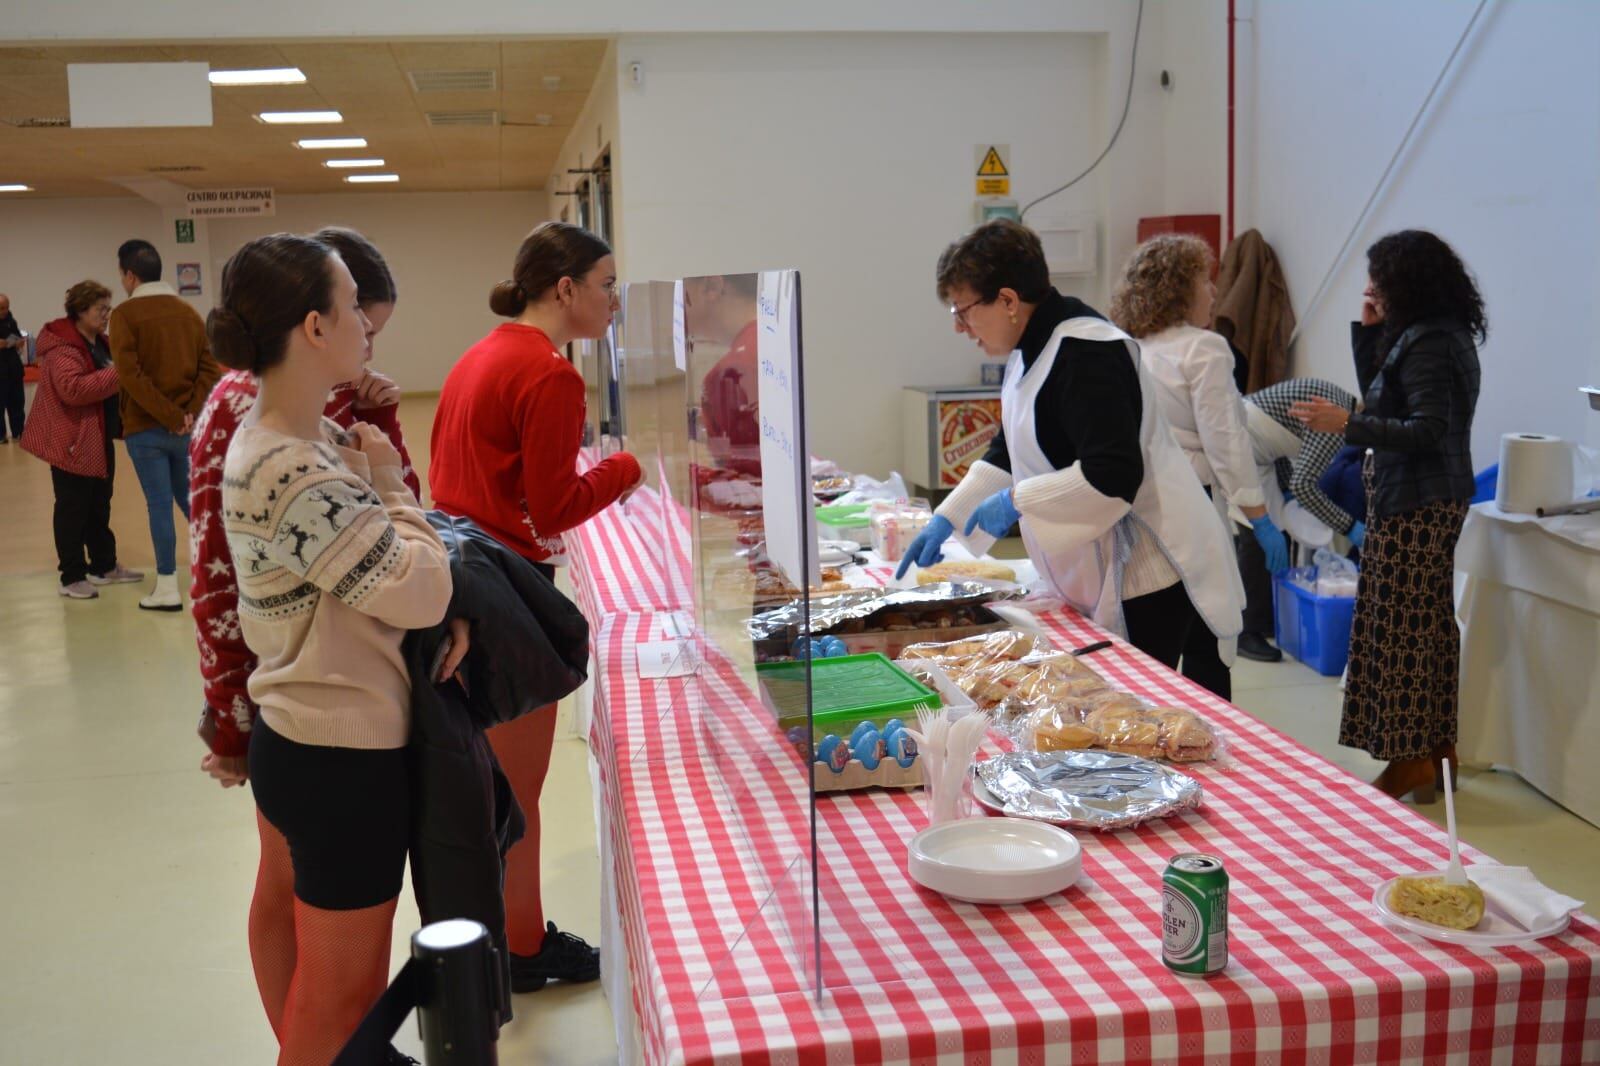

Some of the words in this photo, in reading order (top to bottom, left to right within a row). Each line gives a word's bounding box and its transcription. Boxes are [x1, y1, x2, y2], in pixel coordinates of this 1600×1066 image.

[187, 191, 218, 201] CENTRO
[219, 190, 272, 200] OCUPACIONAL
[333, 567, 364, 598] DEER
[363, 546, 384, 568] OH
[262, 591, 299, 609] DEER
